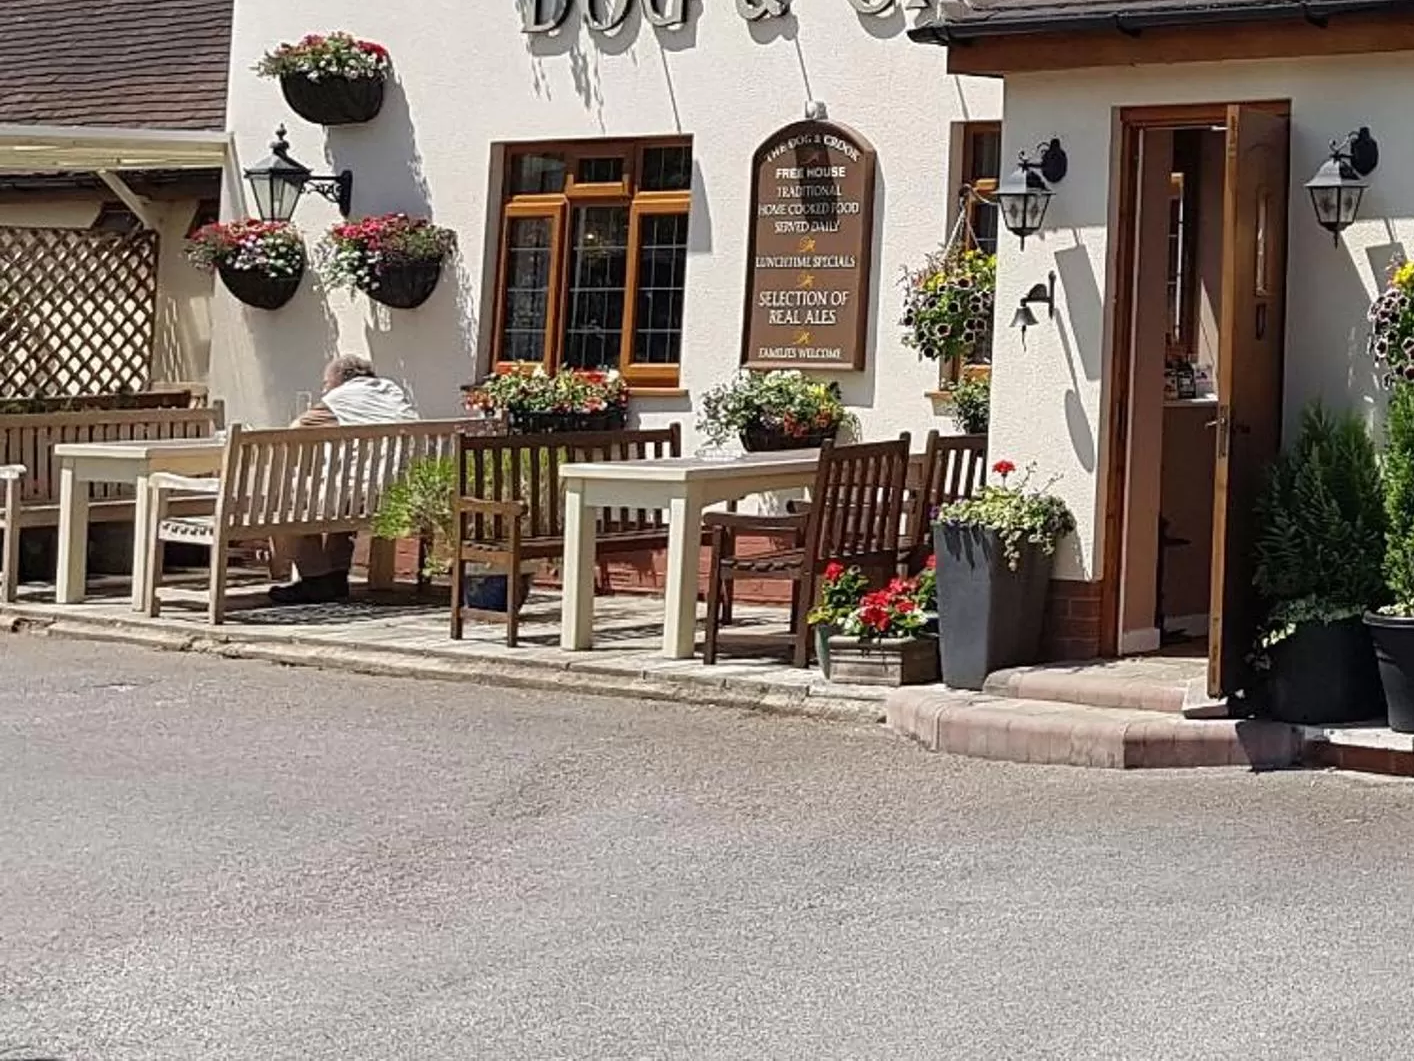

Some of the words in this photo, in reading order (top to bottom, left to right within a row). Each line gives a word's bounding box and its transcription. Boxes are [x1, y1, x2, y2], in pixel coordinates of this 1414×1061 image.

[775, 168, 804, 179] FREE
[806, 166, 847, 178] HOUSE
[777, 185, 842, 197] TRADITIONAL
[759, 203, 787, 215] HOME
[788, 202, 829, 215] COOKED
[831, 201, 859, 214] FOOD
[774, 220, 809, 233] SERVED
[811, 219, 840, 232] DAILY
[756, 256, 811, 268] LUNCHTIME
[812, 255, 856, 268] SPECIALS
[759, 290, 828, 307] SELECTION
[831, 290, 849, 306] OF
[768, 309, 801, 325] REAL
[804, 309, 837, 325] ALES
[758, 347, 796, 359] FAMILIES
[797, 347, 841, 359] WELCOME
